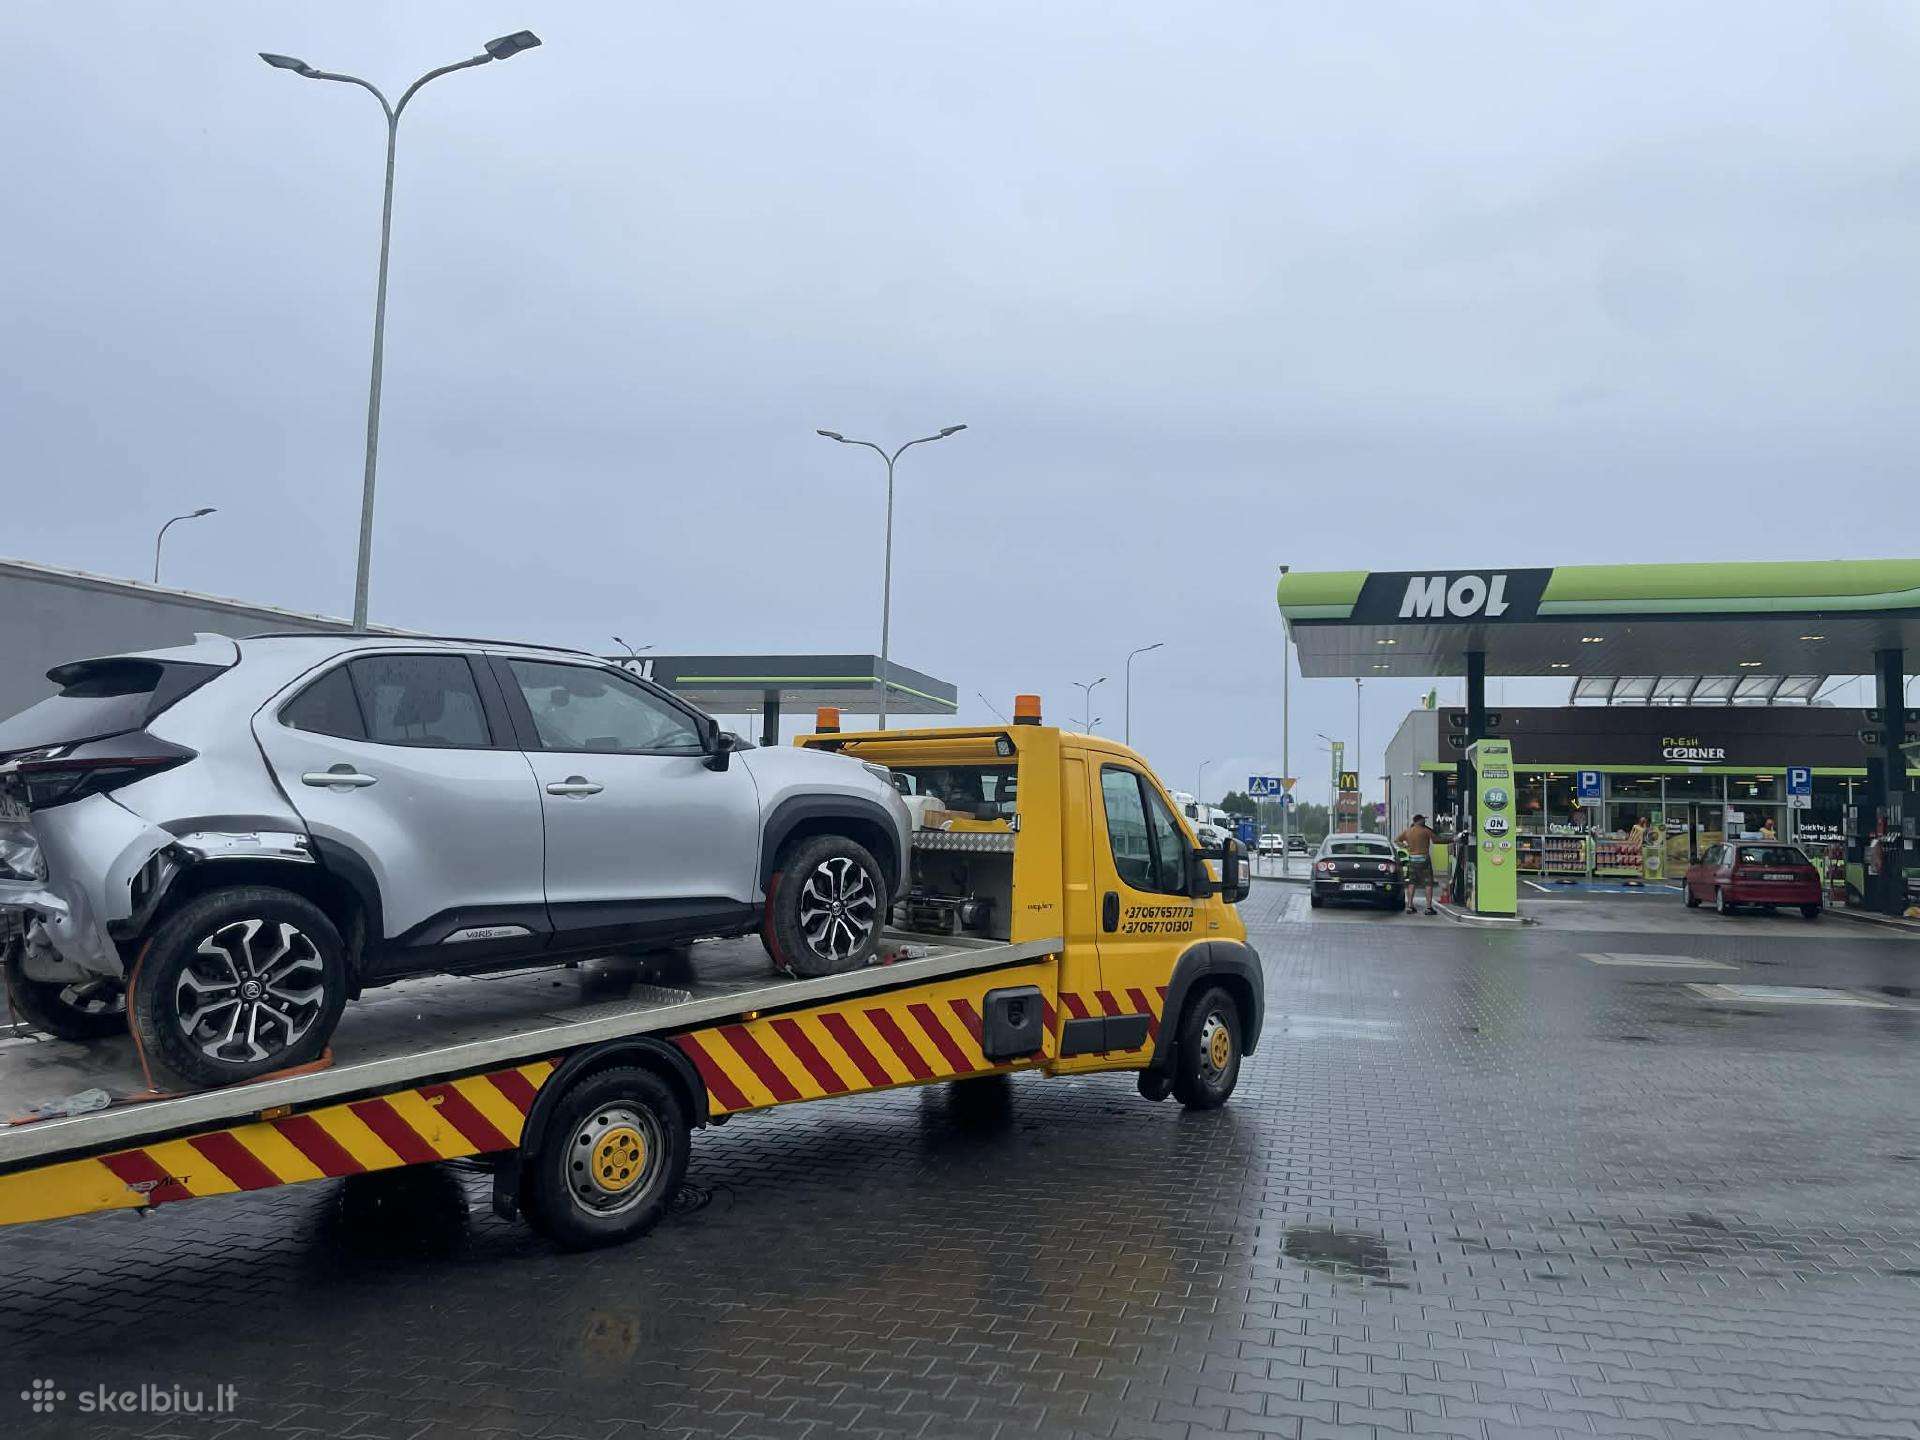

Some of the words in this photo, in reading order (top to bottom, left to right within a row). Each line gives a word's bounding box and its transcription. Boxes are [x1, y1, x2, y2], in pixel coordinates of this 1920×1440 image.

[1398, 575, 1510, 617] MOL
[1662, 747, 1726, 759] CORNER
[1582, 772, 1597, 789] P
[1792, 769, 1807, 787] P
[1490, 819, 1504, 828] ON
[1124, 906, 1195, 919] +37067657773
[1121, 921, 1193, 934] +37067701301
